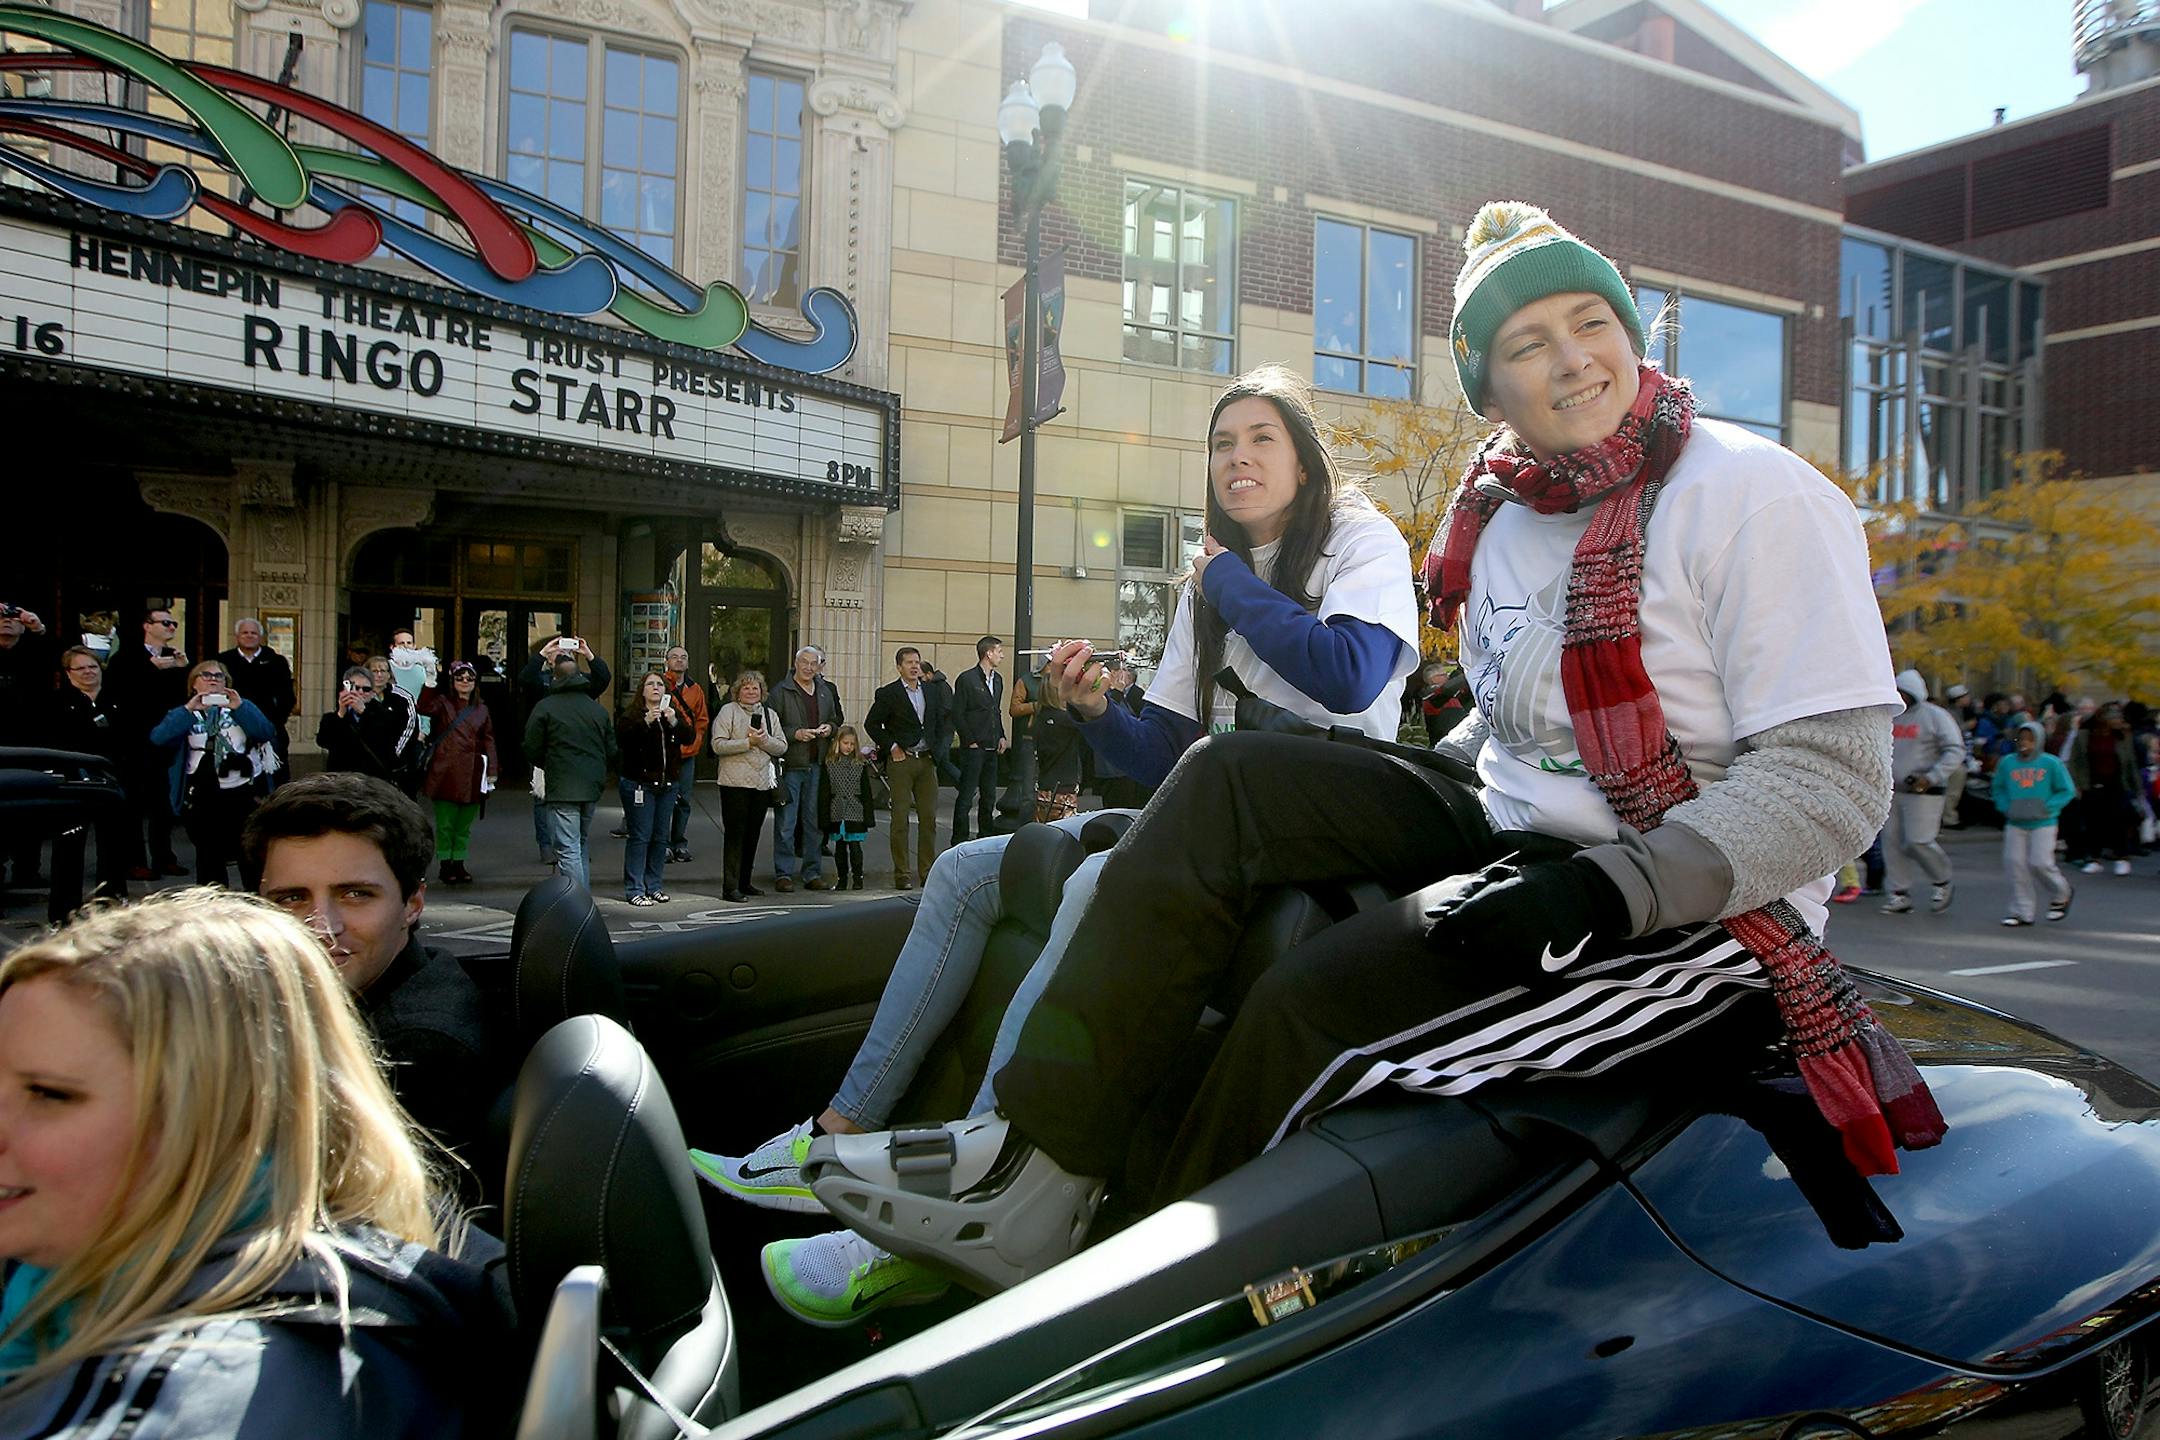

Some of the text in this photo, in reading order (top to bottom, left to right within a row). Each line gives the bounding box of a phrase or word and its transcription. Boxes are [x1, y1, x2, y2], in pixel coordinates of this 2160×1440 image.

[16, 315, 64, 355] 16
[70, 231, 796, 413] HENNEPIN THEATRE TRUST PRESENTS
[244, 313, 677, 440] RINGO STARR
[827, 460, 871, 489] 8PM
